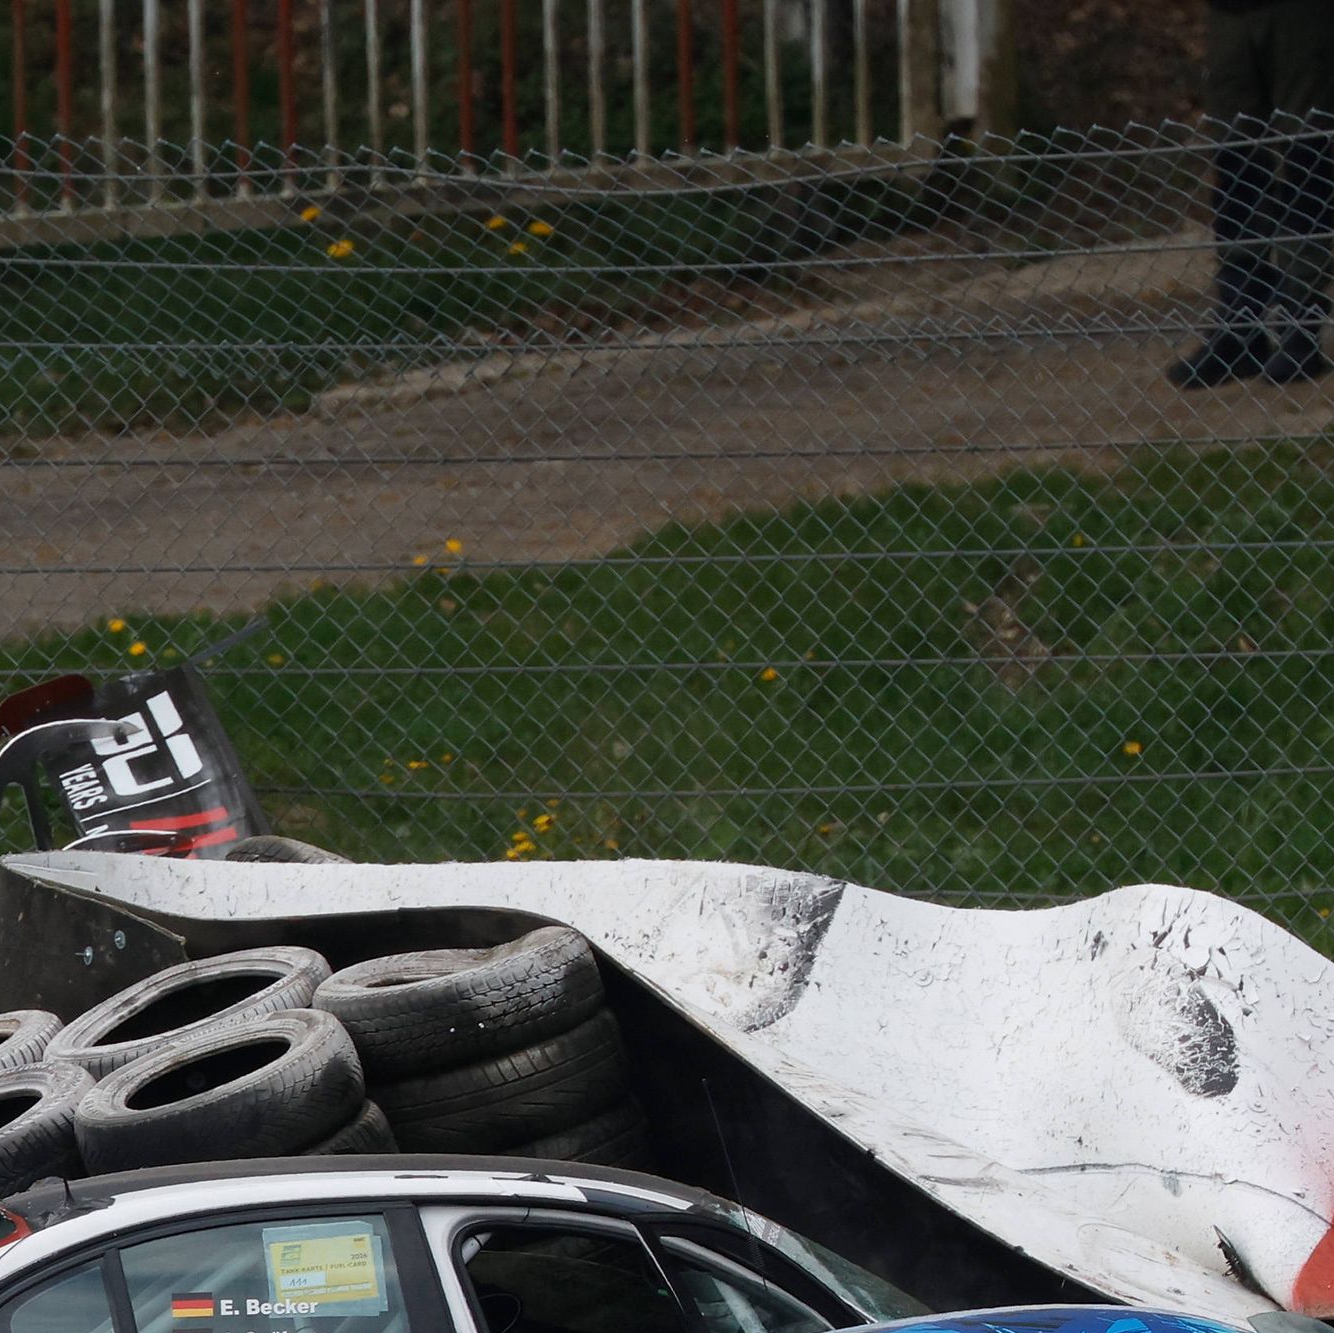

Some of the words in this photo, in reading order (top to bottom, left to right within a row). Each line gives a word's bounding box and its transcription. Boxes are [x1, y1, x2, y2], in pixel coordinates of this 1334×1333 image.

[58, 762, 109, 811] YEARS
[220, 1299, 240, 1316] E.
[246, 1298, 318, 1316] Becker
